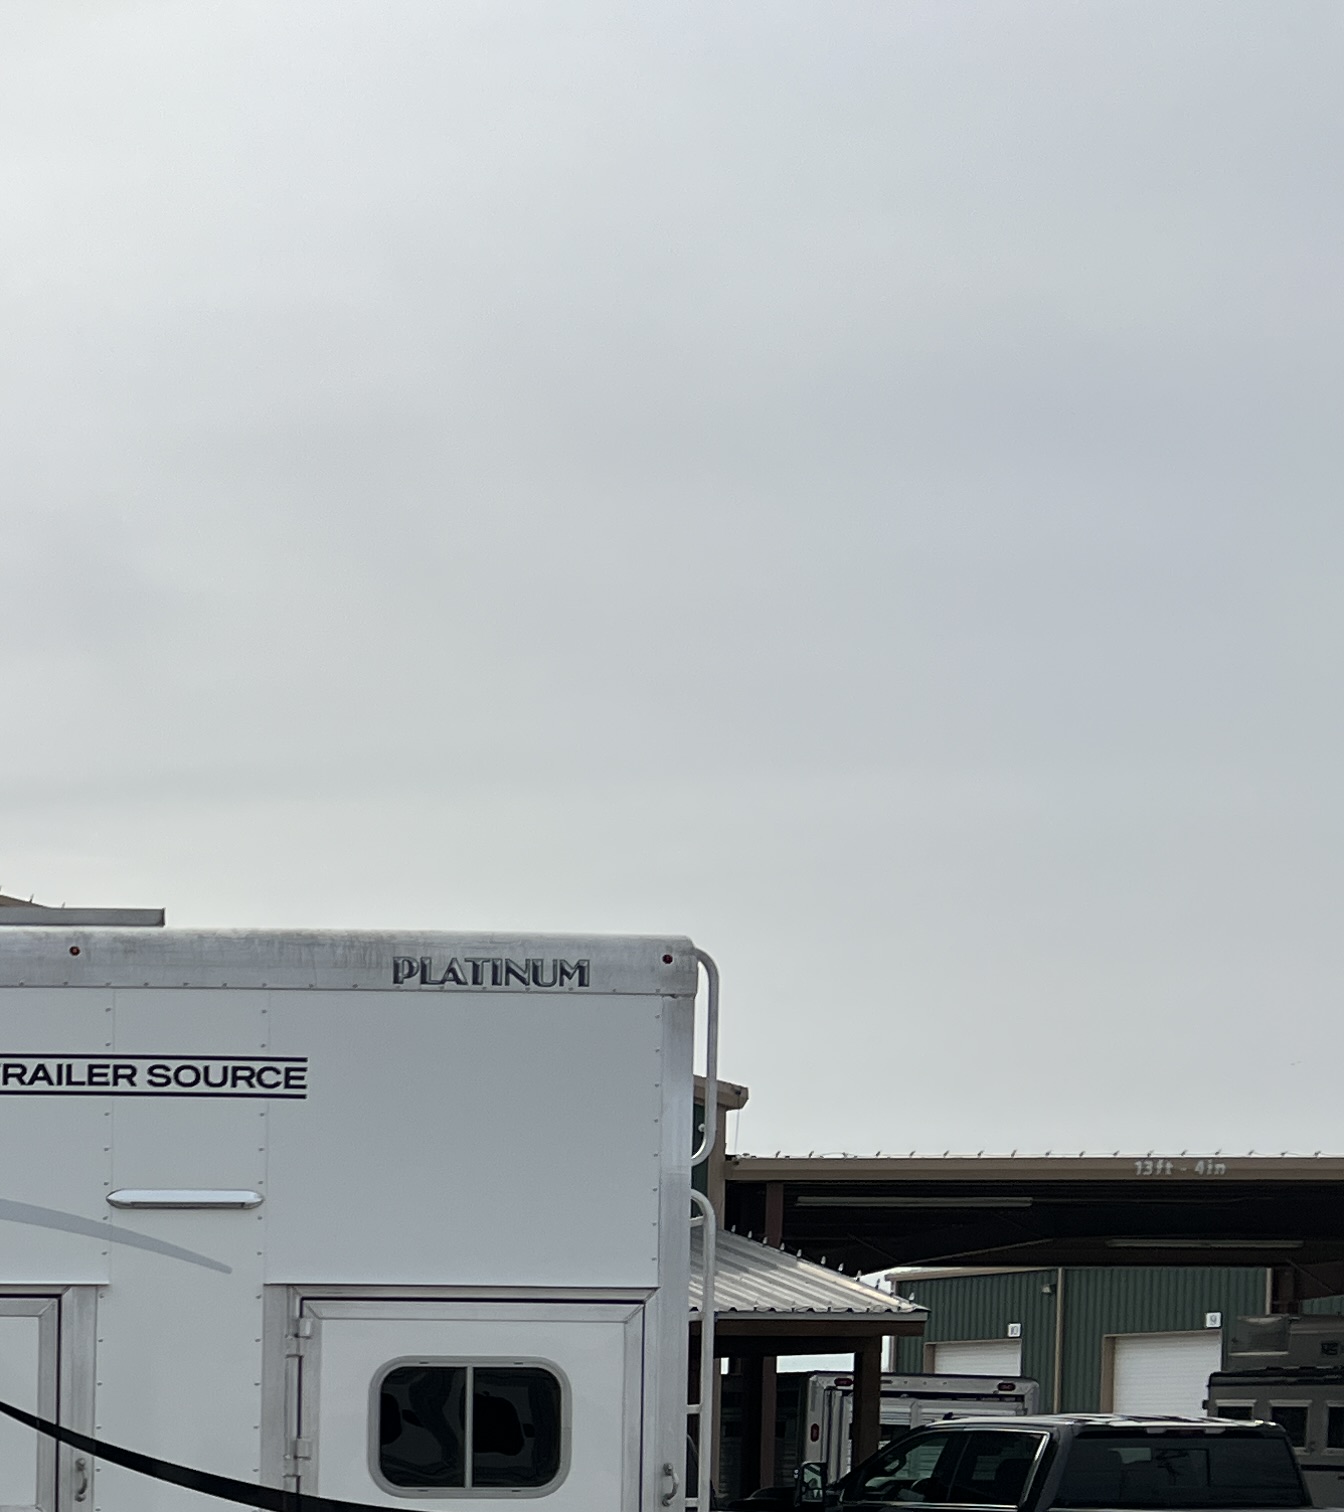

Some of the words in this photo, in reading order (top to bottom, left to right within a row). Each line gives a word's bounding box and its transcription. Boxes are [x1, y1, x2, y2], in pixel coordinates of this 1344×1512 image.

[393, 956, 590, 987] PLATINUM
[146, 1066, 308, 1089] SOURCE
[1134, 1160, 1173, 1176] 13ft
[1194, 1160, 1226, 1175] 4in
